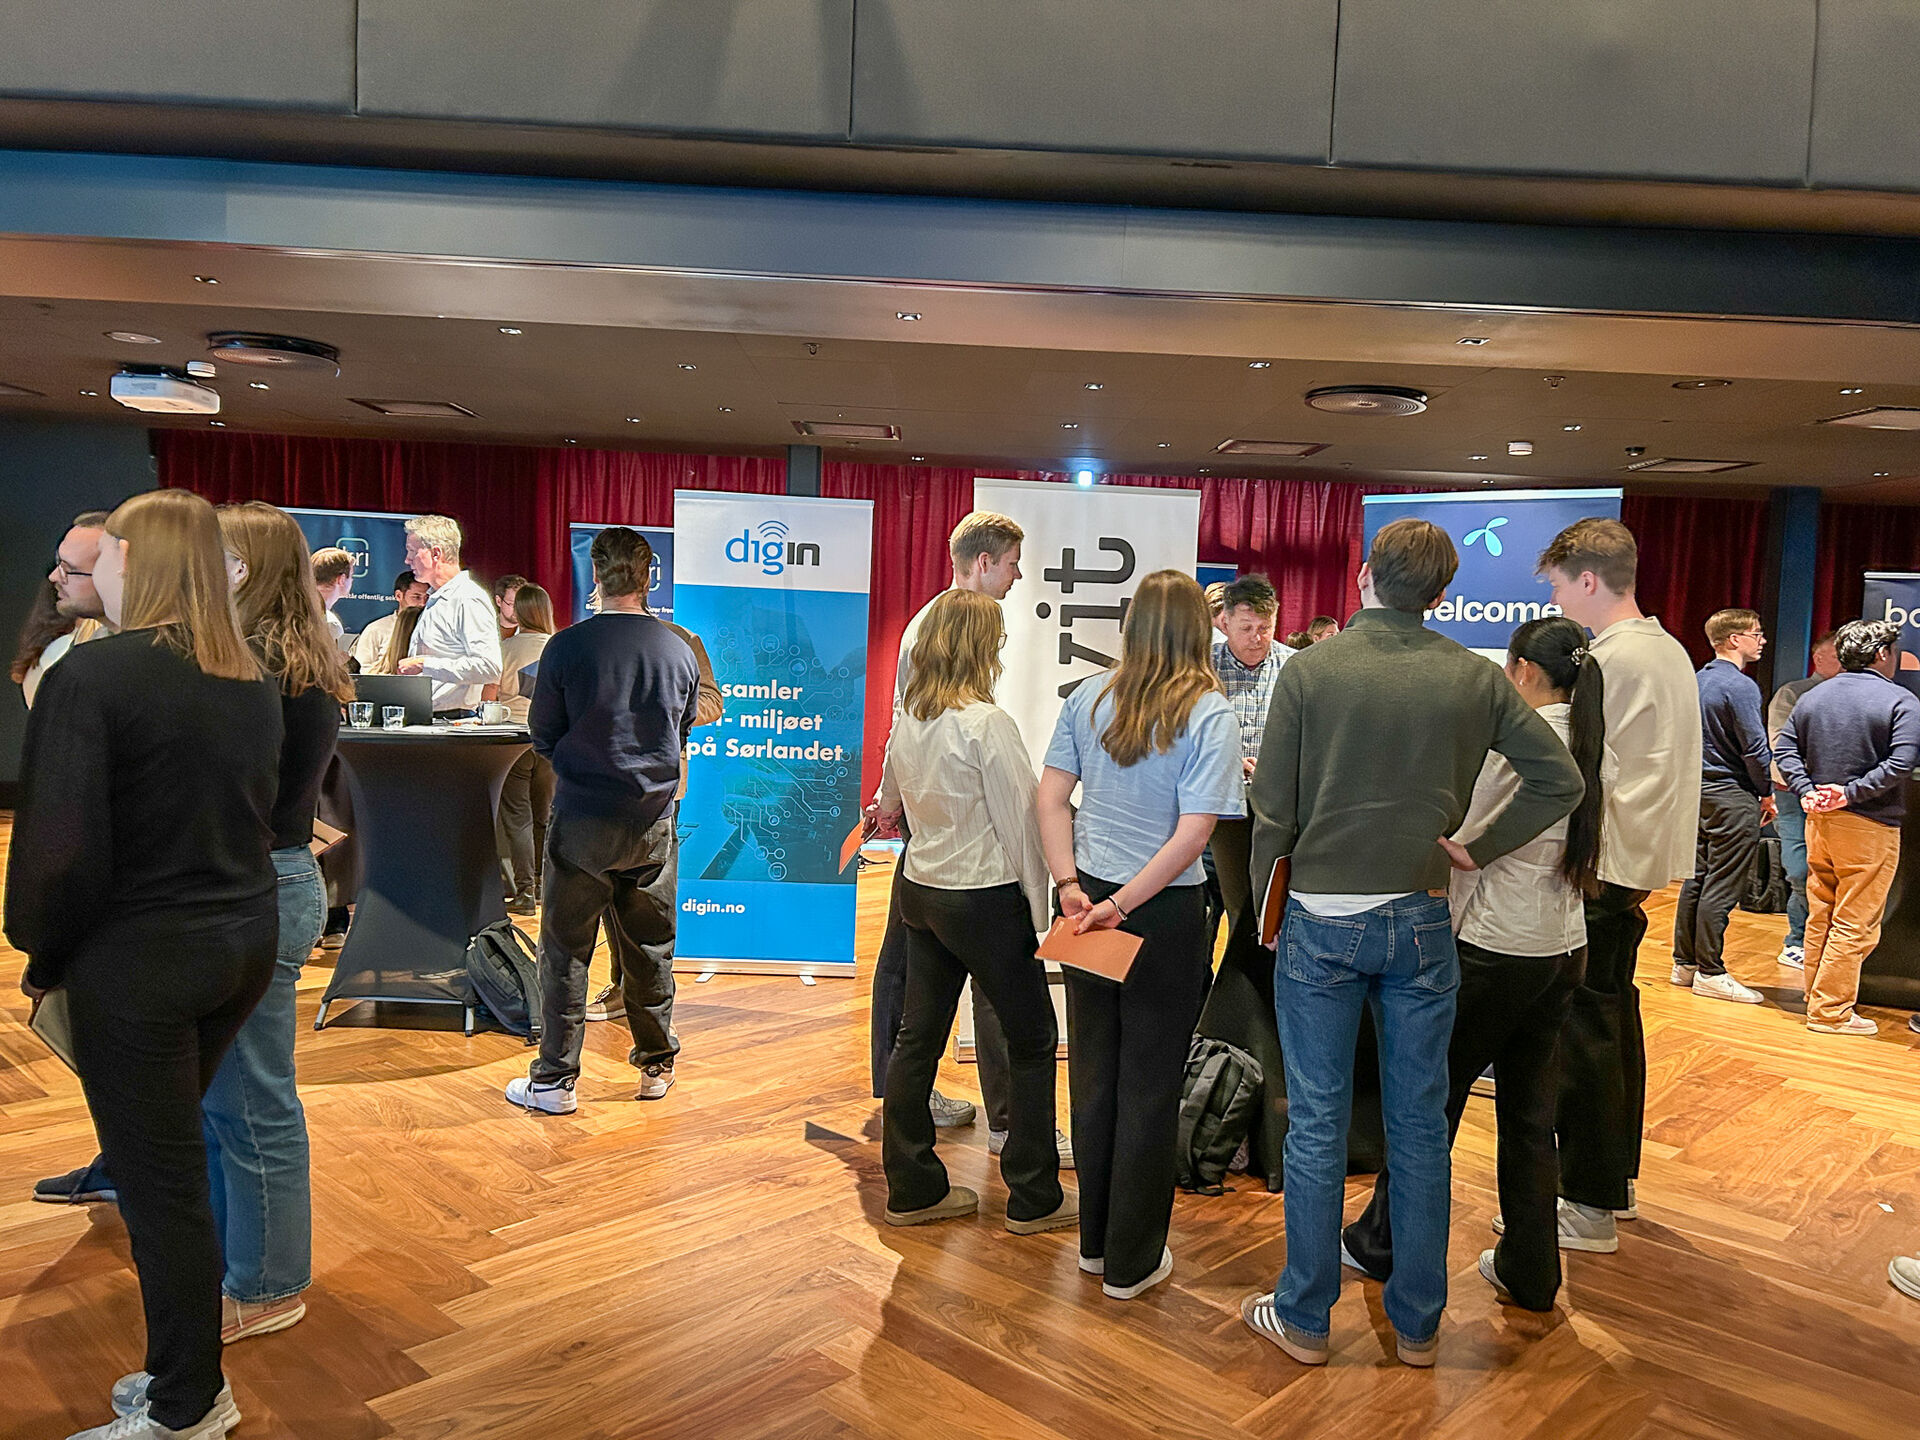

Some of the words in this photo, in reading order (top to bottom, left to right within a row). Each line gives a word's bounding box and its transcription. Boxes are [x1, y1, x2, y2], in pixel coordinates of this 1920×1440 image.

[725, 529, 821, 576] digin
[358, 593, 385, 602] offentlig
[721, 679, 803, 700] samler
[740, 708, 823, 735] miljøet
[686, 736, 717, 761] på
[725, 738, 843, 761] Sørlandet
[681, 898, 746, 916] digin.no
